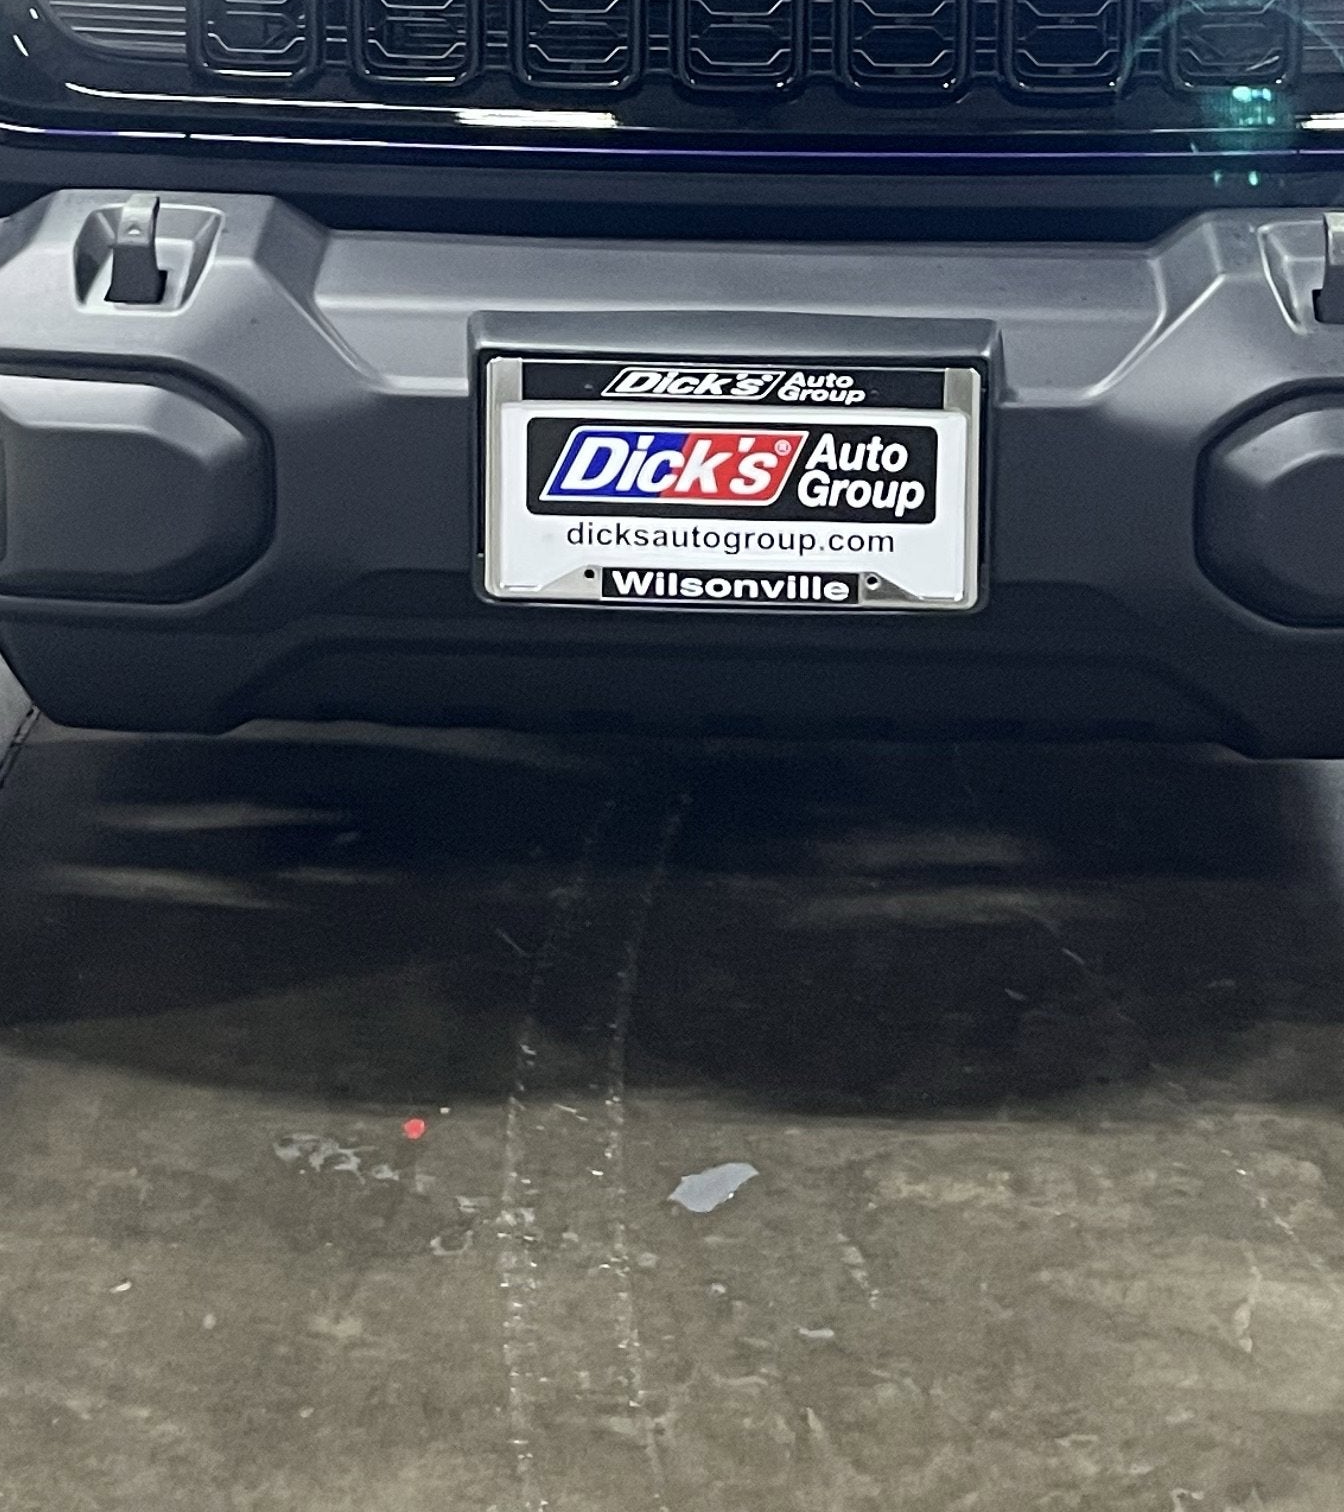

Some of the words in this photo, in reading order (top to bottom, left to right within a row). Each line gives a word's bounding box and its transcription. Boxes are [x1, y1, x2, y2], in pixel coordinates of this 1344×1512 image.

[777, 387, 866, 405] Group
[789, 371, 854, 389] Auto
[806, 433, 908, 473] Auto
[797, 470, 925, 516] Group
[566, 521, 894, 555] dicksautogroup.com
[612, 570, 850, 601] Wilsonville
